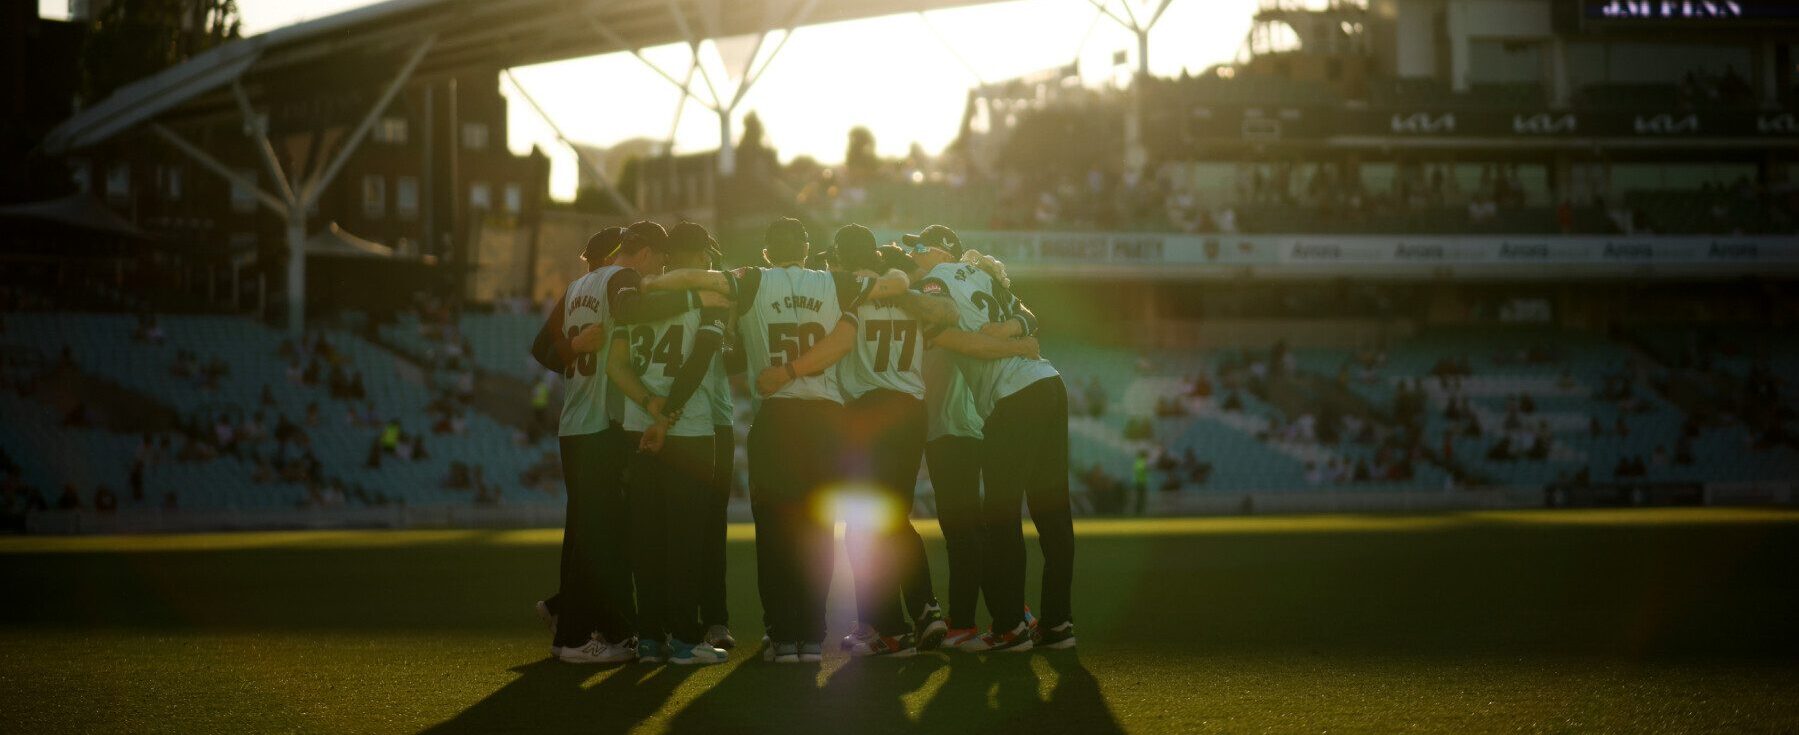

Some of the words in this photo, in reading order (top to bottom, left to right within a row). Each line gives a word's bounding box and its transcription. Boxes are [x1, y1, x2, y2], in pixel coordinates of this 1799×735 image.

[771, 300, 781, 314] T
[631, 324, 684, 377] 34
[865, 320, 918, 372] 77
